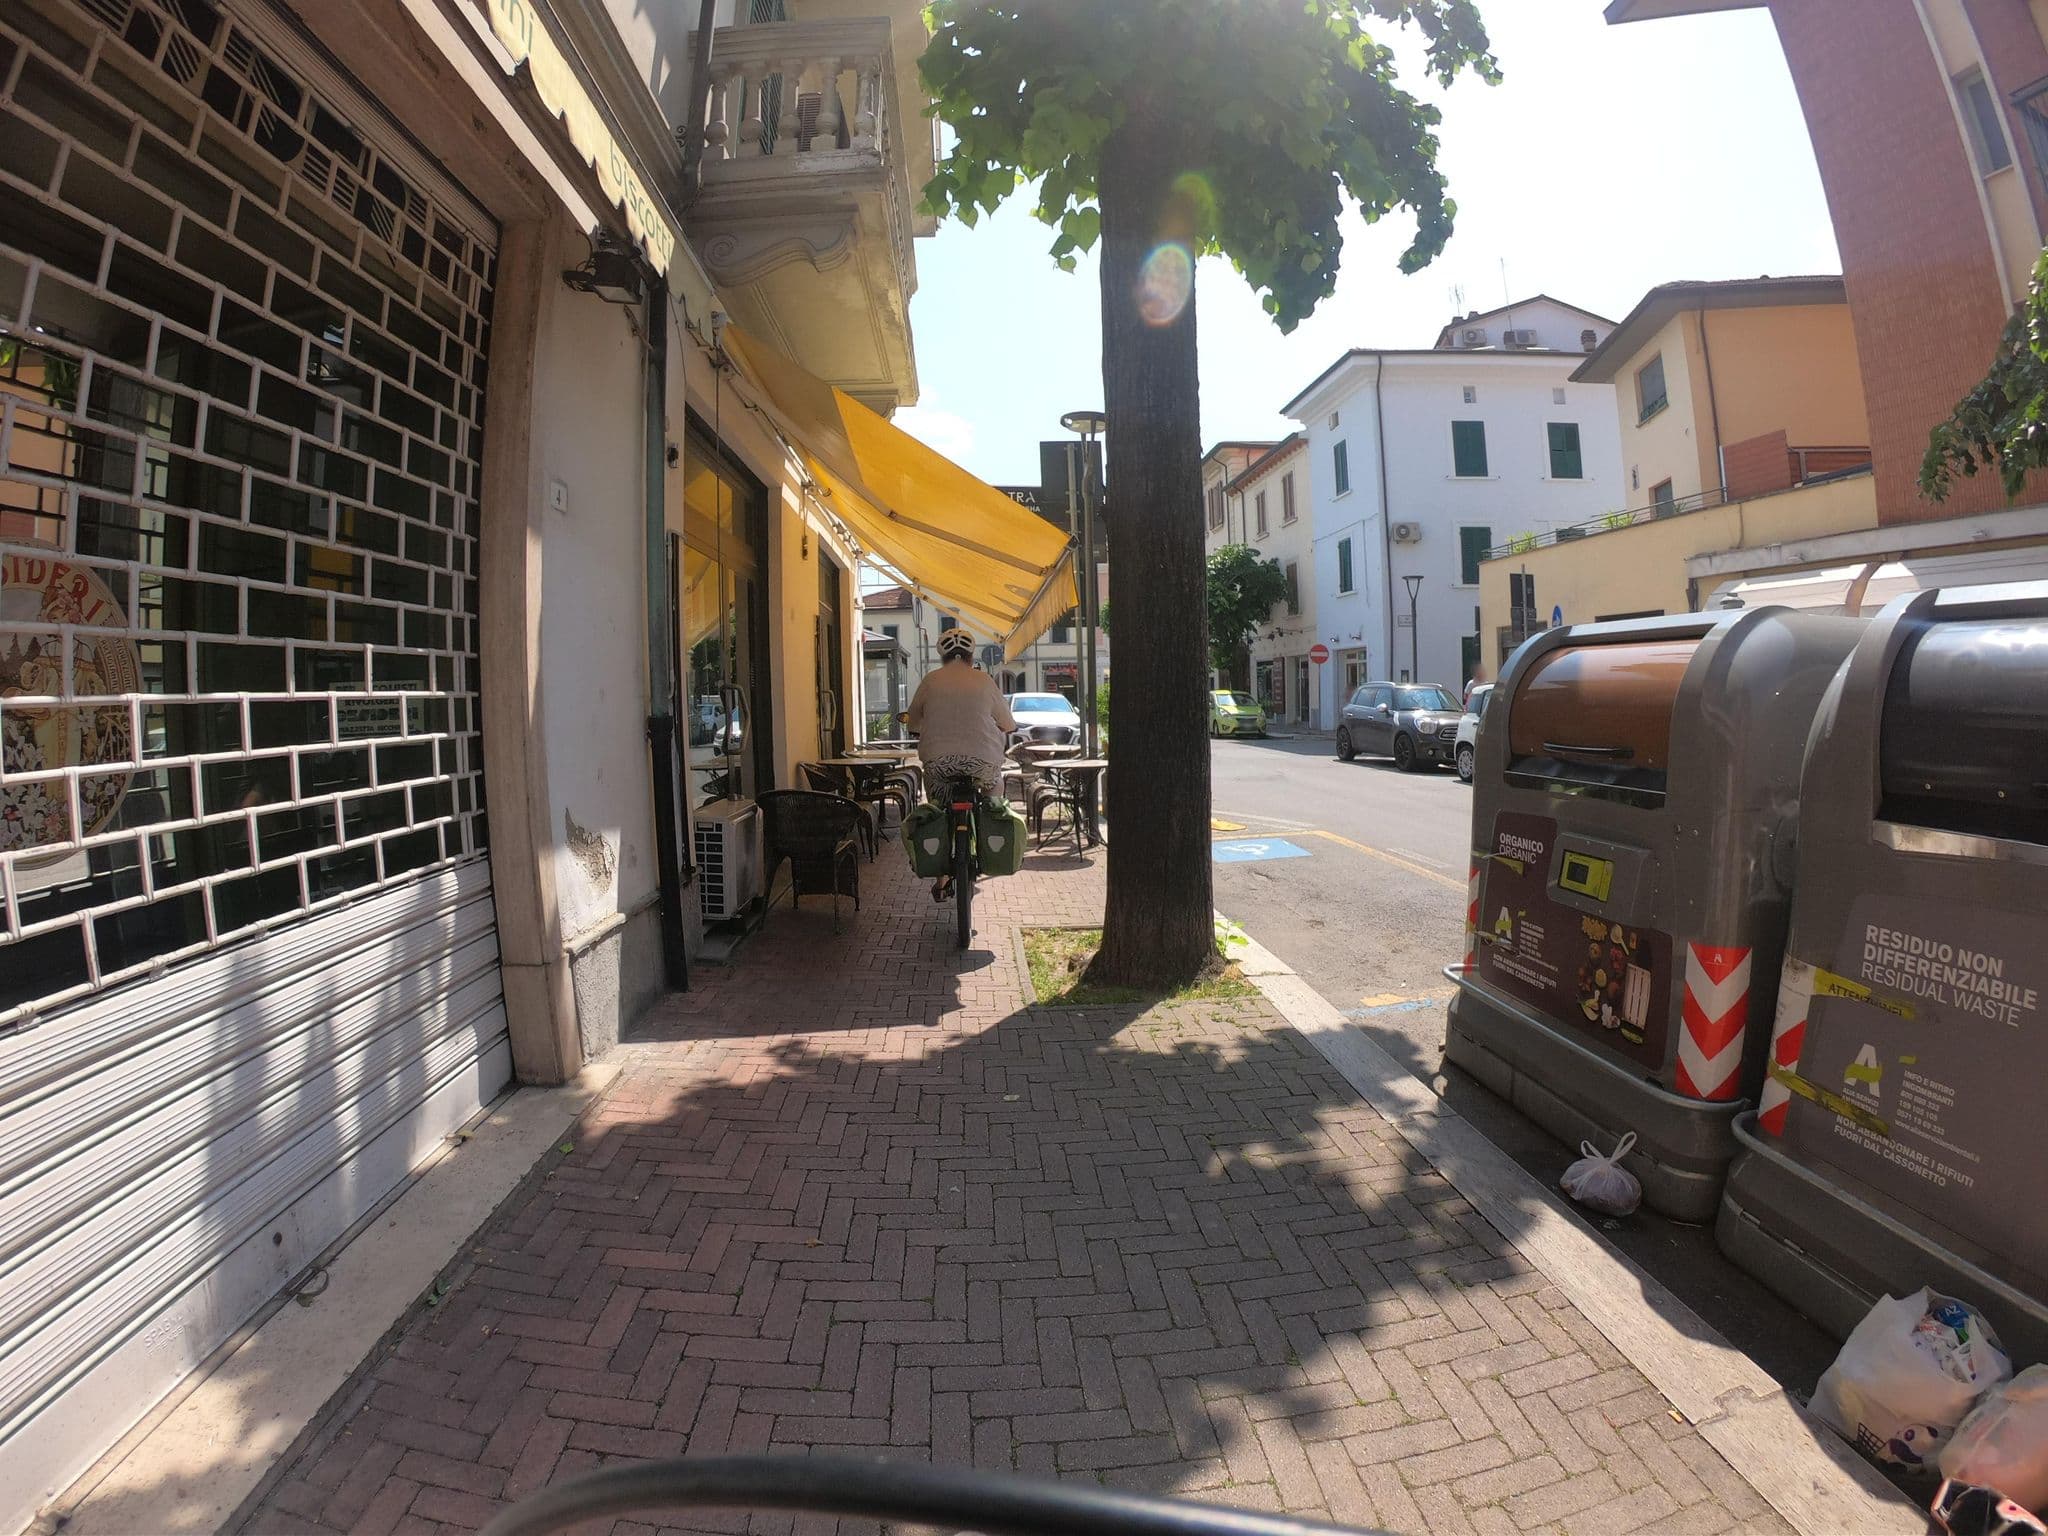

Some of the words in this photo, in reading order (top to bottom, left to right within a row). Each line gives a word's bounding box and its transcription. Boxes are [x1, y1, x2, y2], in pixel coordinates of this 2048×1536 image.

[610, 140, 673, 265] biscotti
[1499, 832, 1544, 855] ORGANICO
[1499, 844, 1537, 864] ORGANIC
[1863, 943, 2037, 1011] DIFFERENZIABILE
[1865, 924, 1952, 963] RESIDUO
[1957, 949, 2003, 978] NON
[1861, 962, 1948, 1005] RESIDUAL
[1953, 989, 2022, 1028] WASTE
[1902, 1079, 1954, 1107] INGOMBRANTI
[1929, 1080, 1955, 1096] RITIRO
[1833, 1125, 1863, 1146] FUORI
[1863, 1140, 1881, 1155] DAL
[1882, 1149, 1946, 1187] CASSONETTO
[1836, 1114, 1857, 1131] NON
[1857, 1124, 1930, 1167] ABBANDONARE
[1936, 1162, 1975, 1188] RIFIUTI
